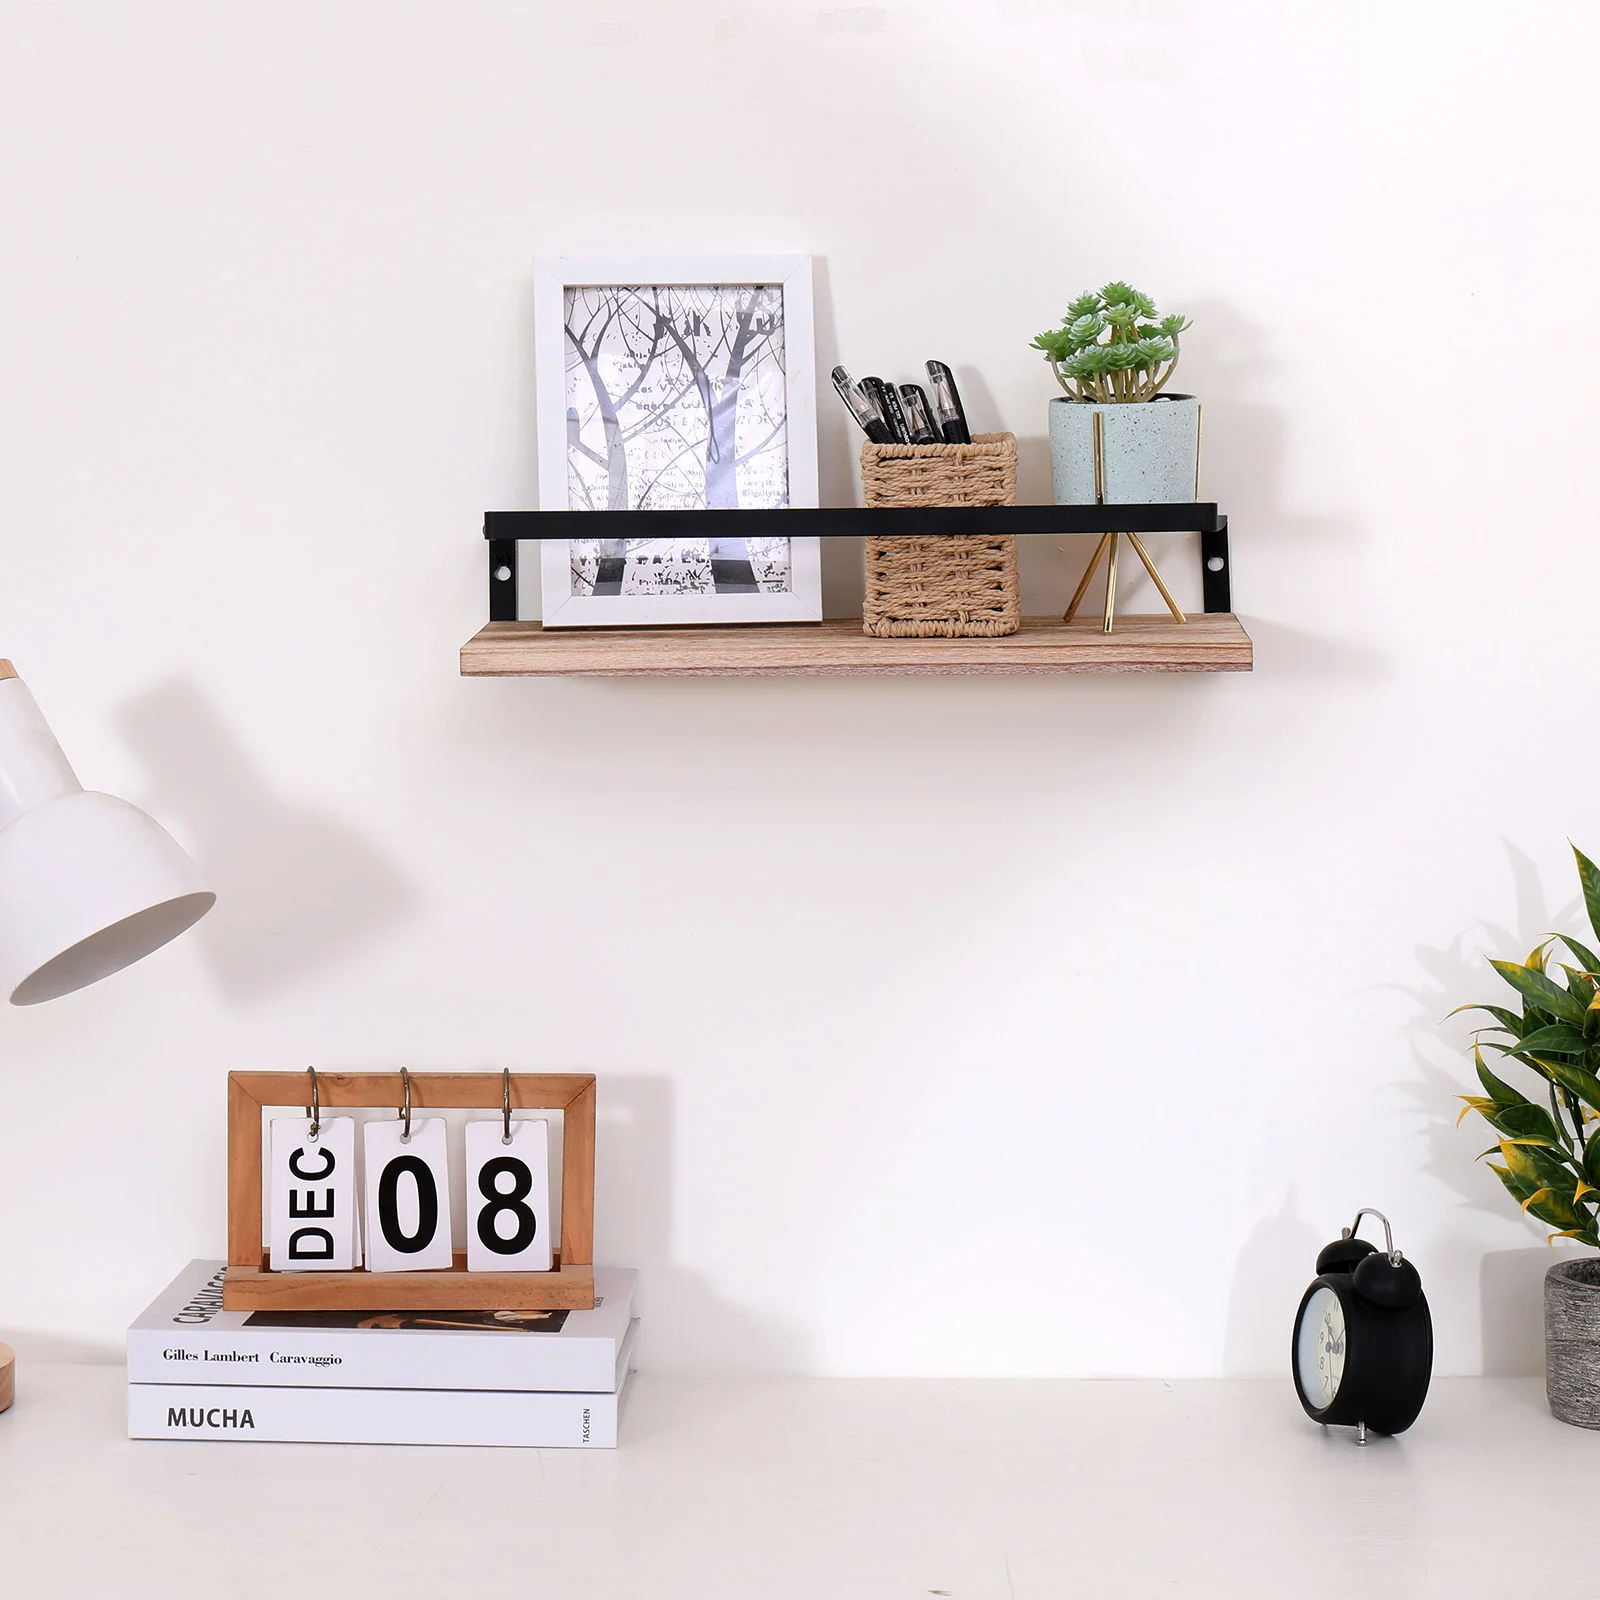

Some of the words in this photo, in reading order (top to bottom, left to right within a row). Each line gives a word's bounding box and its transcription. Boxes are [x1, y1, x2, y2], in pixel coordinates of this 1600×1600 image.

[289, 1147, 336, 1260] DEC
[172, 1266, 228, 1324] CARAVA
[162, 1348, 199, 1361] Gilles
[204, 1349, 260, 1363] Lambert
[269, 1351, 343, 1368] Caravaggio
[167, 1407, 255, 1429] MUCHA
[582, 1408, 590, 1443] TASCHEN
